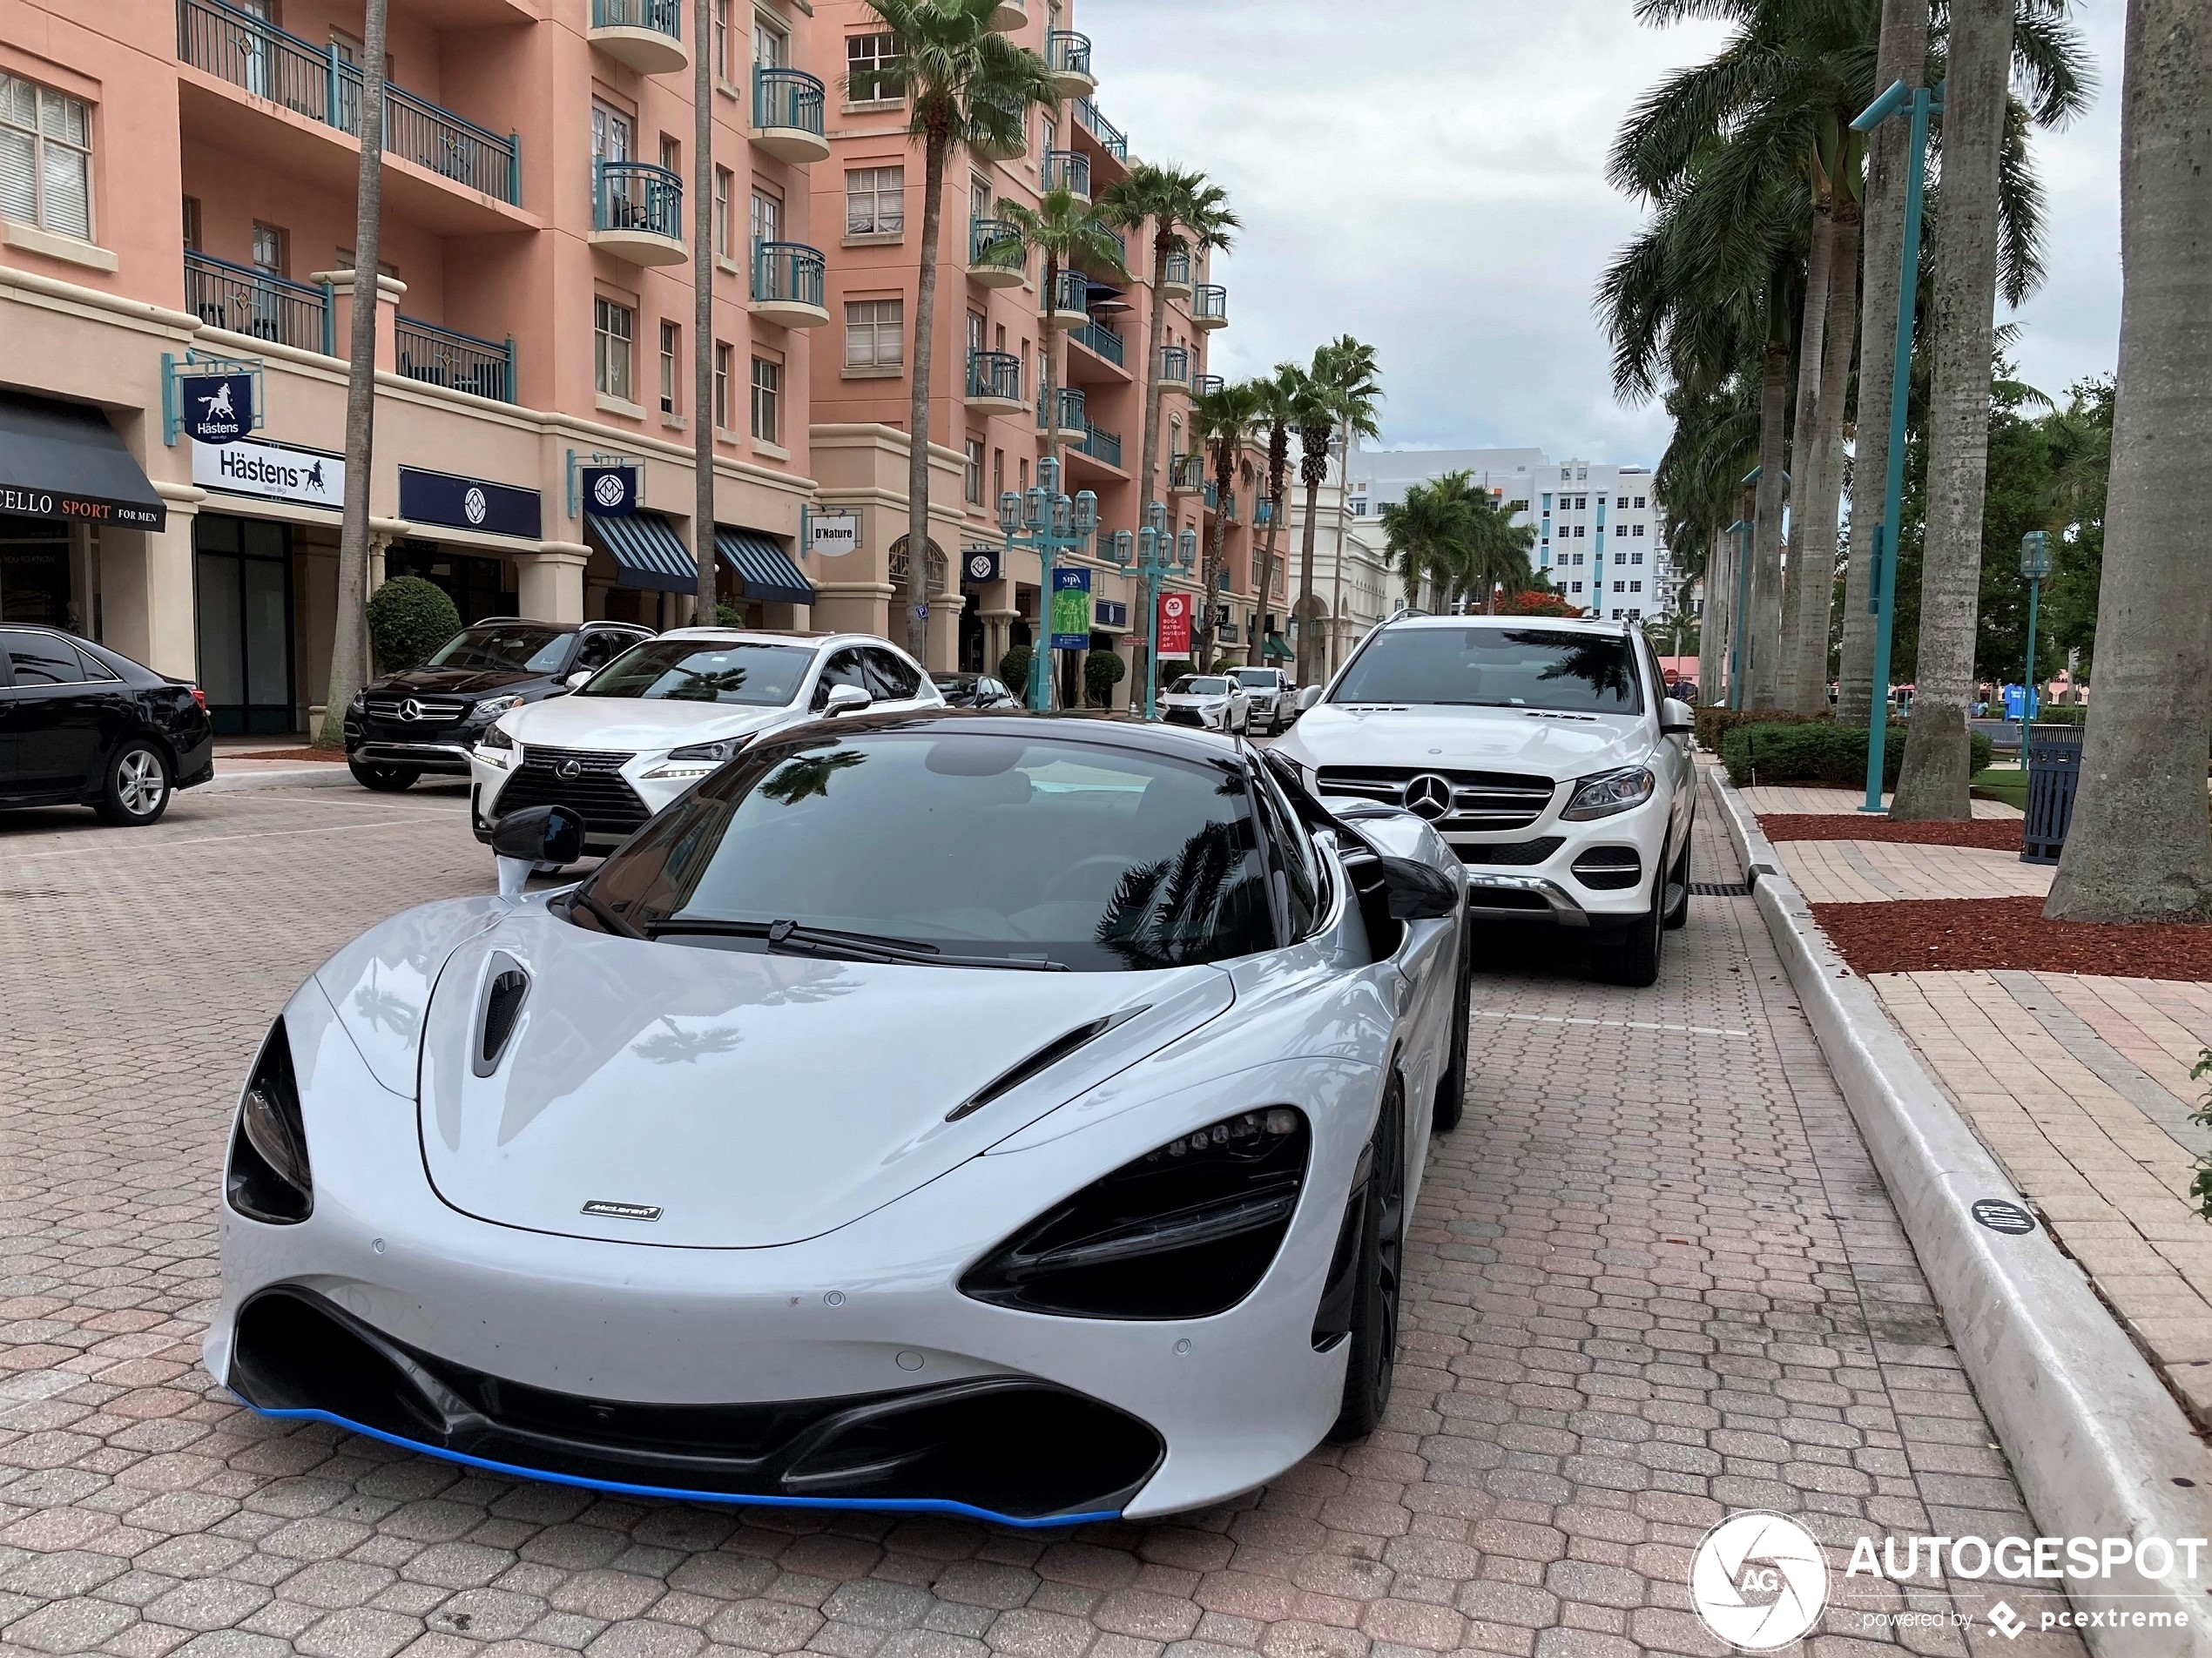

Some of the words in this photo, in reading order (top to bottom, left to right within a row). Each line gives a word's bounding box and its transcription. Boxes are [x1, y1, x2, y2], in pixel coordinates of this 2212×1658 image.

[197, 421, 239, 434] Hästens
[220, 449, 298, 488] Hästens
[62, 500, 111, 519] SPORT
[118, 509, 136, 520] FOR
[138, 511, 158, 522] MEN
[815, 528, 853, 539] D'Nature
[1168, 601, 1179, 610] 20
[588, 1204, 650, 1216] McLaren
